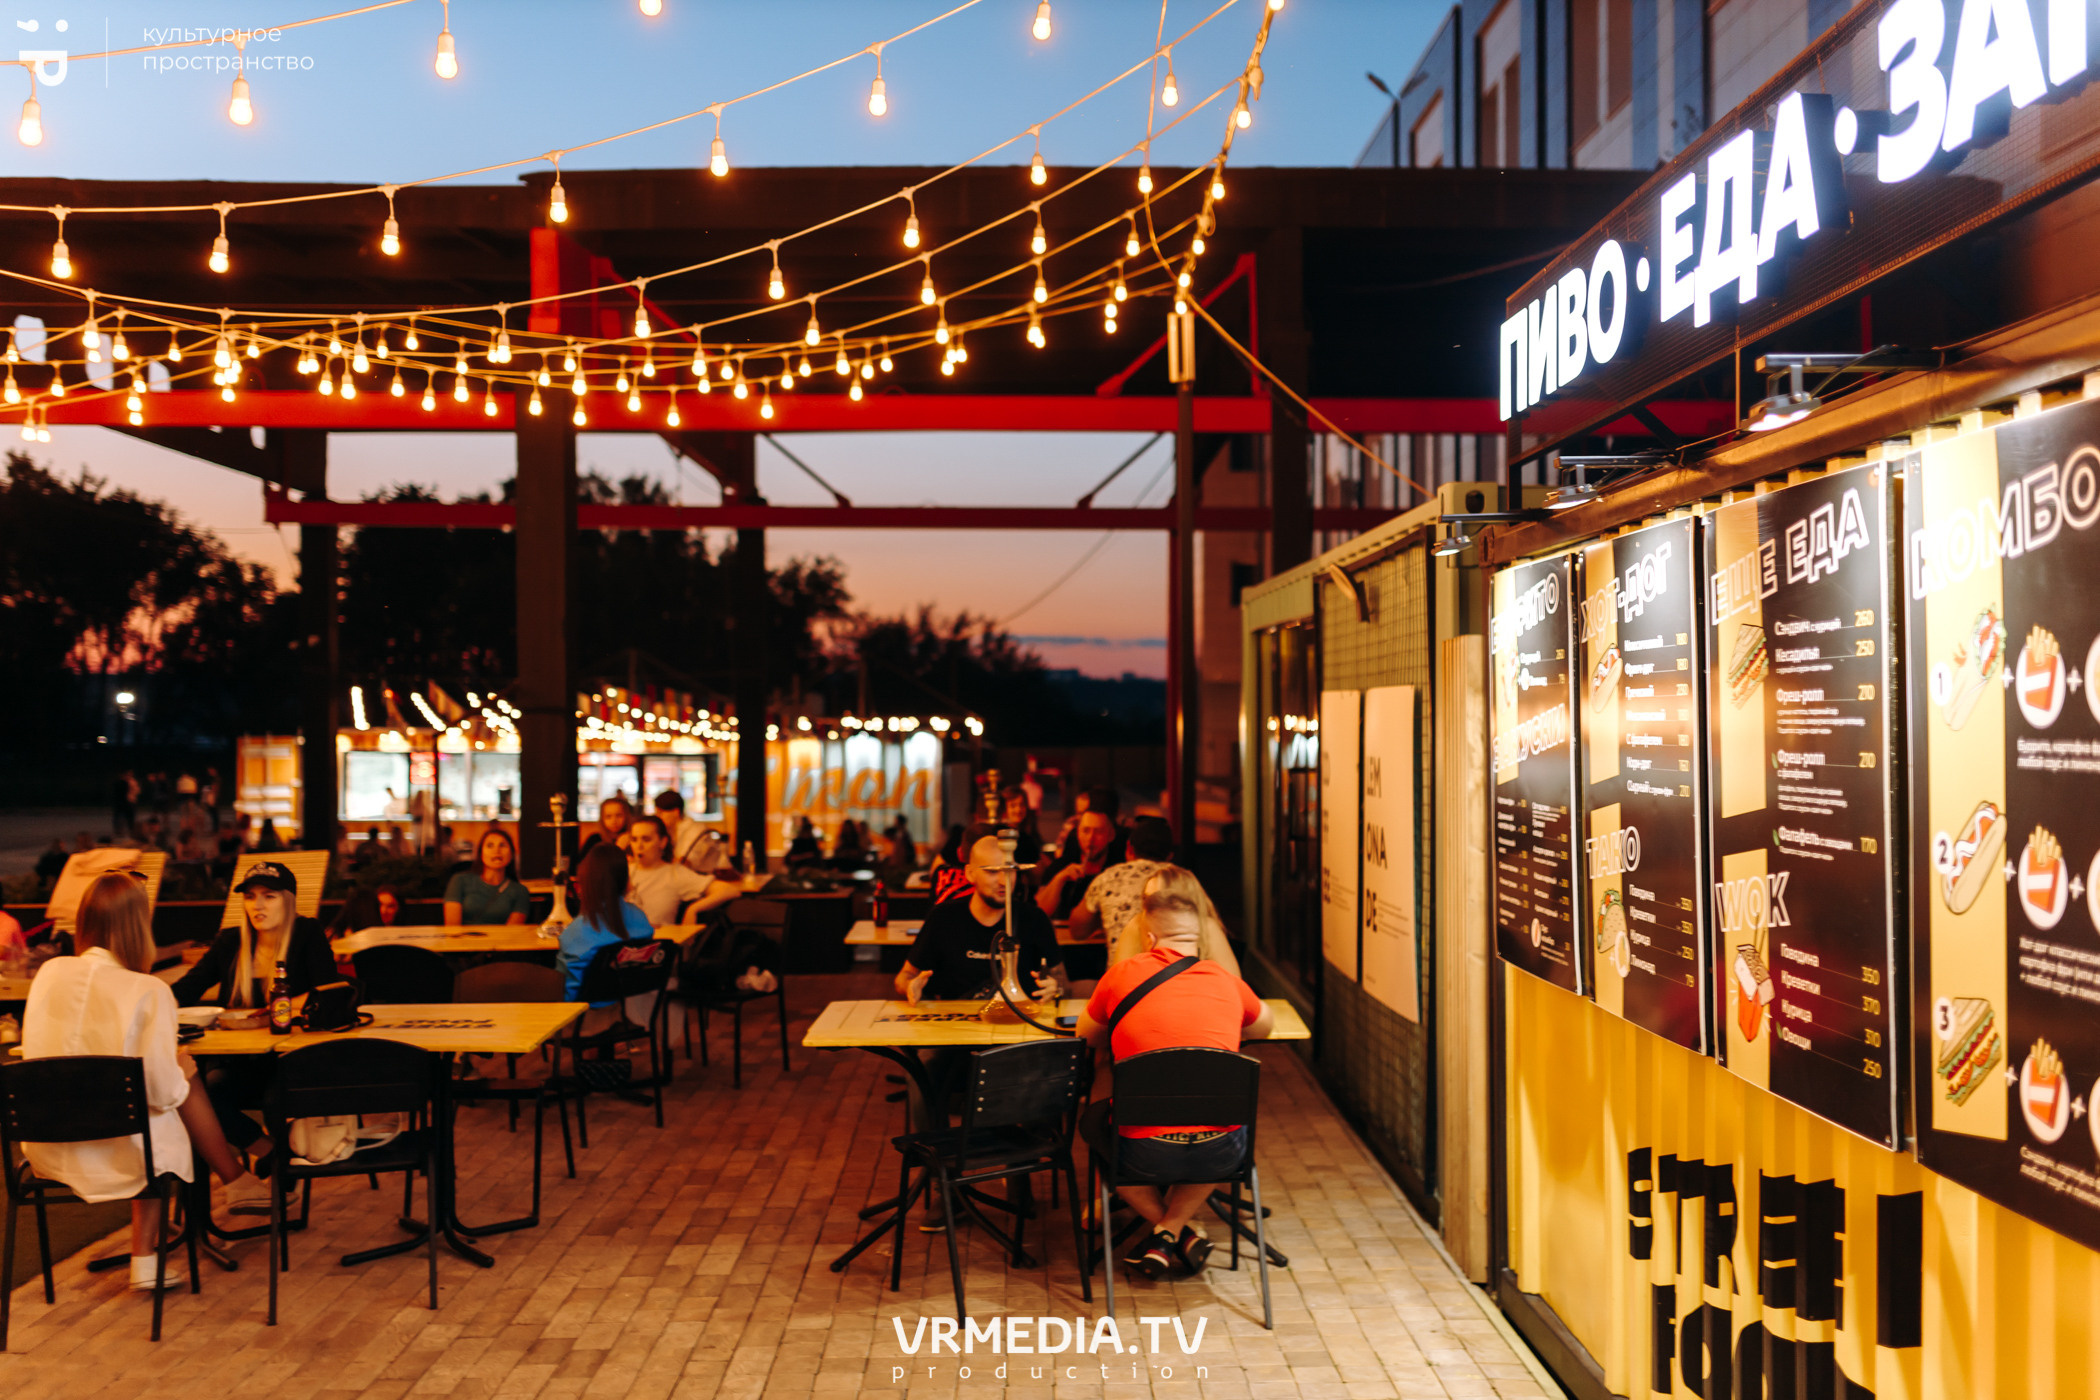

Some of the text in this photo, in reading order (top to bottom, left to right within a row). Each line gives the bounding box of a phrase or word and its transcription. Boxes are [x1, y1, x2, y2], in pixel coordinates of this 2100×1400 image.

[1500, 239, 1627, 422] ПИВО
[1660, 91, 1820, 328] ЕДА
[1785, 486, 1871, 584] ЕДА
[1586, 825, 1641, 880] ТАКО
[1938, 838, 1949, 865] 2
[1715, 870, 1791, 933] WOK
[1939, 1005, 1950, 1032] 3
